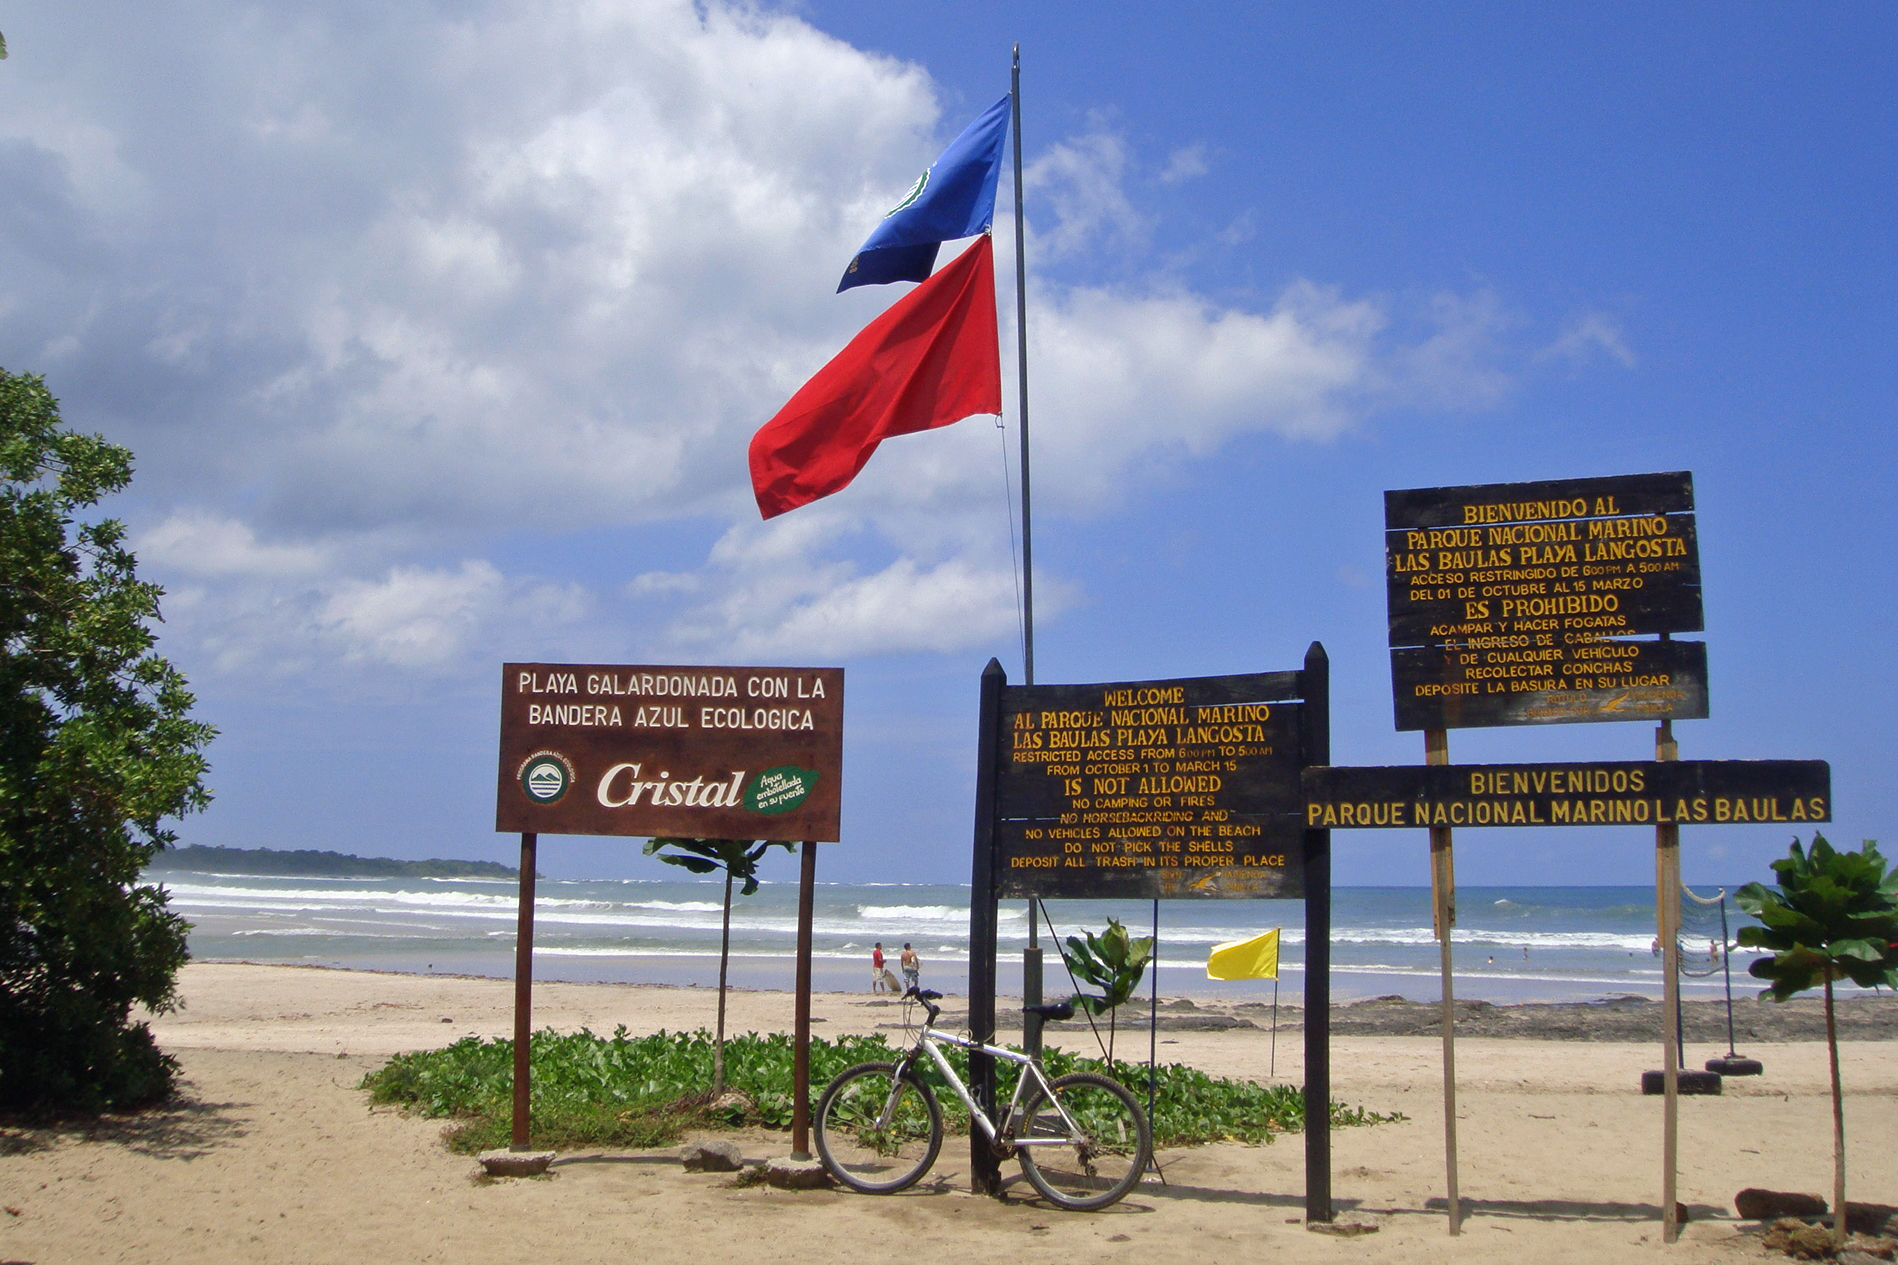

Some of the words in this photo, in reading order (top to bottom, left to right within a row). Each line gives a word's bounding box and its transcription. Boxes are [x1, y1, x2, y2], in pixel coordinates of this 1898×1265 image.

[1463, 498, 1587, 525] BIENVENIDO
[1594, 495, 1620, 515] AL
[1407, 528, 1482, 550] PARQUE
[1488, 522, 1582, 546] NACIONAL
[1588, 516, 1668, 539] MARINO
[1395, 551, 1430, 572] LAS
[1438, 546, 1512, 570] BAULAS
[1519, 542, 1577, 566] PLAYA
[1584, 537, 1687, 562] LANGOSTA
[1410, 572, 1464, 586] ACCESO
[1470, 568, 1556, 583] RESTRINGIDO
[1560, 566, 1578, 577] DE
[1626, 562, 1636, 574] A
[1410, 589, 1434, 602] DEL
[1437, 588, 1451, 599] 01
[1458, 587, 1476, 599] DE
[1483, 583, 1546, 597] OCTUBRE
[1553, 581, 1570, 594] AL
[1572, 580, 1586, 592] 15
[1592, 577, 1643, 590] MARZO
[1465, 600, 1489, 620] ES
[1502, 594, 1619, 616] PROHIBIDO
[1430, 622, 1493, 636] ACAMPAR
[1498, 621, 1507, 633] Y
[1513, 618, 1559, 631] HACER
[1564, 615, 1626, 629] FOGATAS
[1444, 639, 1461, 651] EL
[1467, 635, 1529, 650] INGRESO
[1536, 634, 1554, 646] DE
[1443, 655, 1453, 665] Y
[1460, 652, 1479, 665] DE
[1487, 649, 1564, 664] CUALQUIER
[1465, 664, 1553, 679] RECOLECTAR
[1562, 661, 1633, 674] CONCHAS
[518, 672, 578, 694] PLAYA
[587, 674, 738, 698] GALARDONADA
[747, 676, 788, 699] CON
[797, 677, 826, 699] LA
[1104, 686, 1185, 708] WELCOME
[1415, 682, 1479, 697] DEPOSITE
[1487, 681, 1504, 693] LA
[1510, 677, 1567, 692] BASURA
[1575, 676, 1594, 690] EN
[1598, 676, 1617, 689] SU
[1621, 674, 1670, 687] LUGAR
[528, 704, 622, 727] BANDERA
[634, 706, 689, 728] AZUL
[701, 708, 814, 731] ECOLOGICA
[1014, 712, 1035, 730] AL
[1040, 710, 1103, 728] PARQUE
[1110, 707, 1189, 727] NACIONAL
[1198, 704, 1270, 724] MARINO
[1012, 731, 1043, 749] LAS
[1049, 729, 1110, 748] BAULAS
[1117, 727, 1167, 746] PLAYA
[1176, 724, 1265, 745] LANGOSTA
[1012, 750, 1081, 763] RESTRICTED
[1087, 749, 1134, 761] ACCESS
[1140, 748, 1175, 760] FROM
[1219, 746, 1236, 757] TO
[1047, 764, 1080, 776] FROM
[1085, 762, 1141, 775] OCTOBER
[1143, 762, 1149, 773] 1
[1152, 761, 1170, 774] TO
[1176, 760, 1220, 772] MARCH
[1223, 759, 1237, 771] 15
[597, 762, 745, 808] Cristal
[756, 775, 802, 801] embotellada
[760, 773, 783, 788] Agua
[1064, 779, 1082, 796] IS
[1093, 777, 1130, 795] NOT
[1138, 775, 1222, 794] ALLOWED
[1470, 770, 1646, 795] BIENVENIDOS
[758, 800, 768, 809] en
[768, 796, 778, 805] su
[779, 784, 805, 805] fuente
[1072, 797, 1090, 809] NO
[1095, 797, 1148, 808] CAMPING
[1153, 796, 1172, 807] OR
[1180, 795, 1215, 807] FIRES
[1060, 812, 1078, 824] NO
[1082, 810, 1194, 824] HORSEBACKRIDING
[1202, 809, 1228, 822] AND
[1307, 803, 1406, 826] PARQUE
[1414, 801, 1545, 825] NACIONAL
[1551, 800, 1649, 823] MARINO
[1656, 799, 1708, 822] LAS
[1714, 797, 1826, 822] BAULAS
[1025, 828, 1043, 839] NO
[1048, 827, 1100, 839] VEHICLES
[1108, 826, 1161, 838] ALLOWED
[1166, 825, 1185, 837] ON
[1190, 825, 1212, 837] THE
[1219, 824, 1261, 836] BEACH
[1064, 841, 1082, 853] DO
[1091, 840, 1118, 853] NOT
[1124, 840, 1152, 852] PICK
[1159, 840, 1181, 852] THE
[1188, 840, 1234, 852] SHELLS
[1011, 856, 1059, 868] DEPOSIT
[1064, 856, 1086, 867] ALL
[1095, 855, 1137, 867] TRASH
[1142, 855, 1156, 867] IN
[1160, 855, 1179, 867] ITS
[1184, 854, 1235, 867] PROPER
[1243, 854, 1285, 866] PLACE
